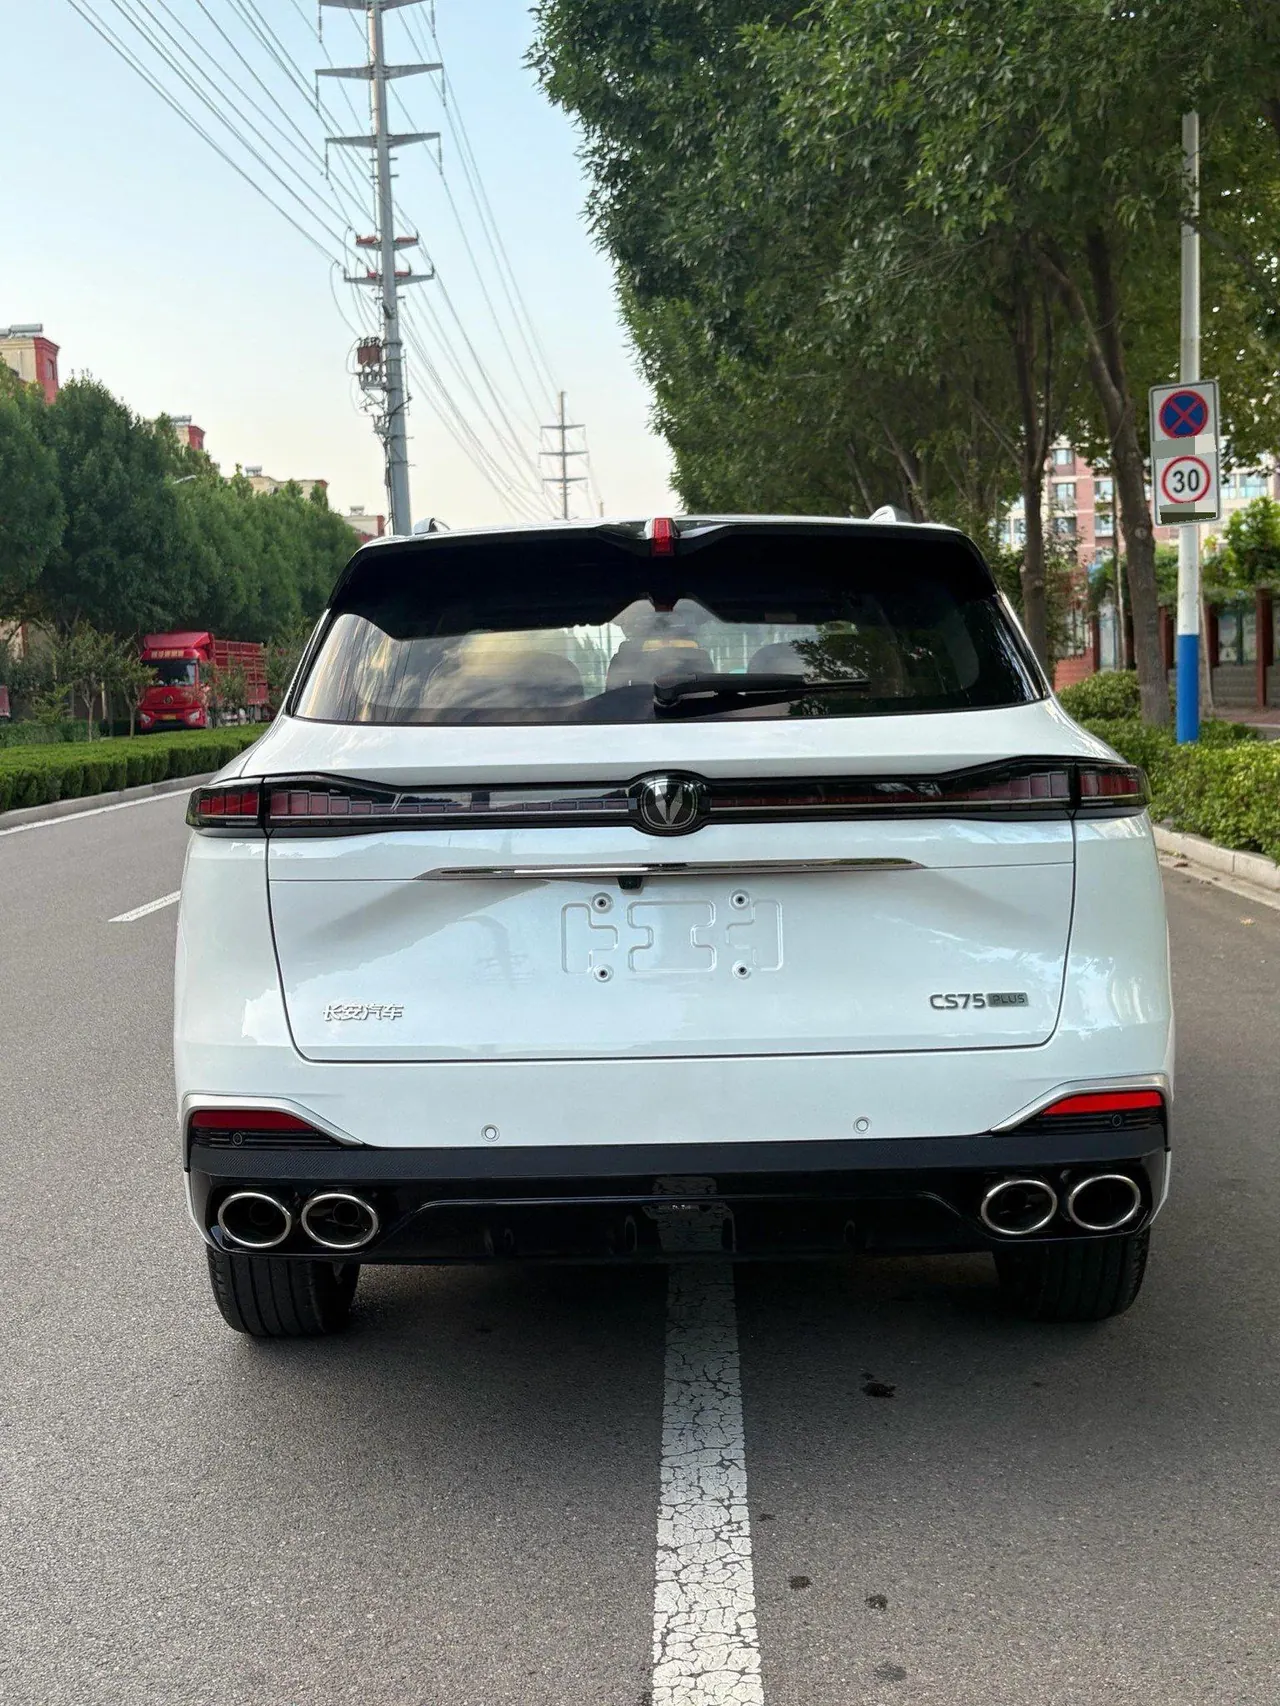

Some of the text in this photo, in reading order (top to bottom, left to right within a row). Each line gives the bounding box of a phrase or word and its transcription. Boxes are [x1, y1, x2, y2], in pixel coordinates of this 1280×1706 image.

[1172, 469, 1200, 494] 30
[929, 993, 1026, 1010] CS75 PLUS
[323, 1003, 404, 1021] 长安汽车
